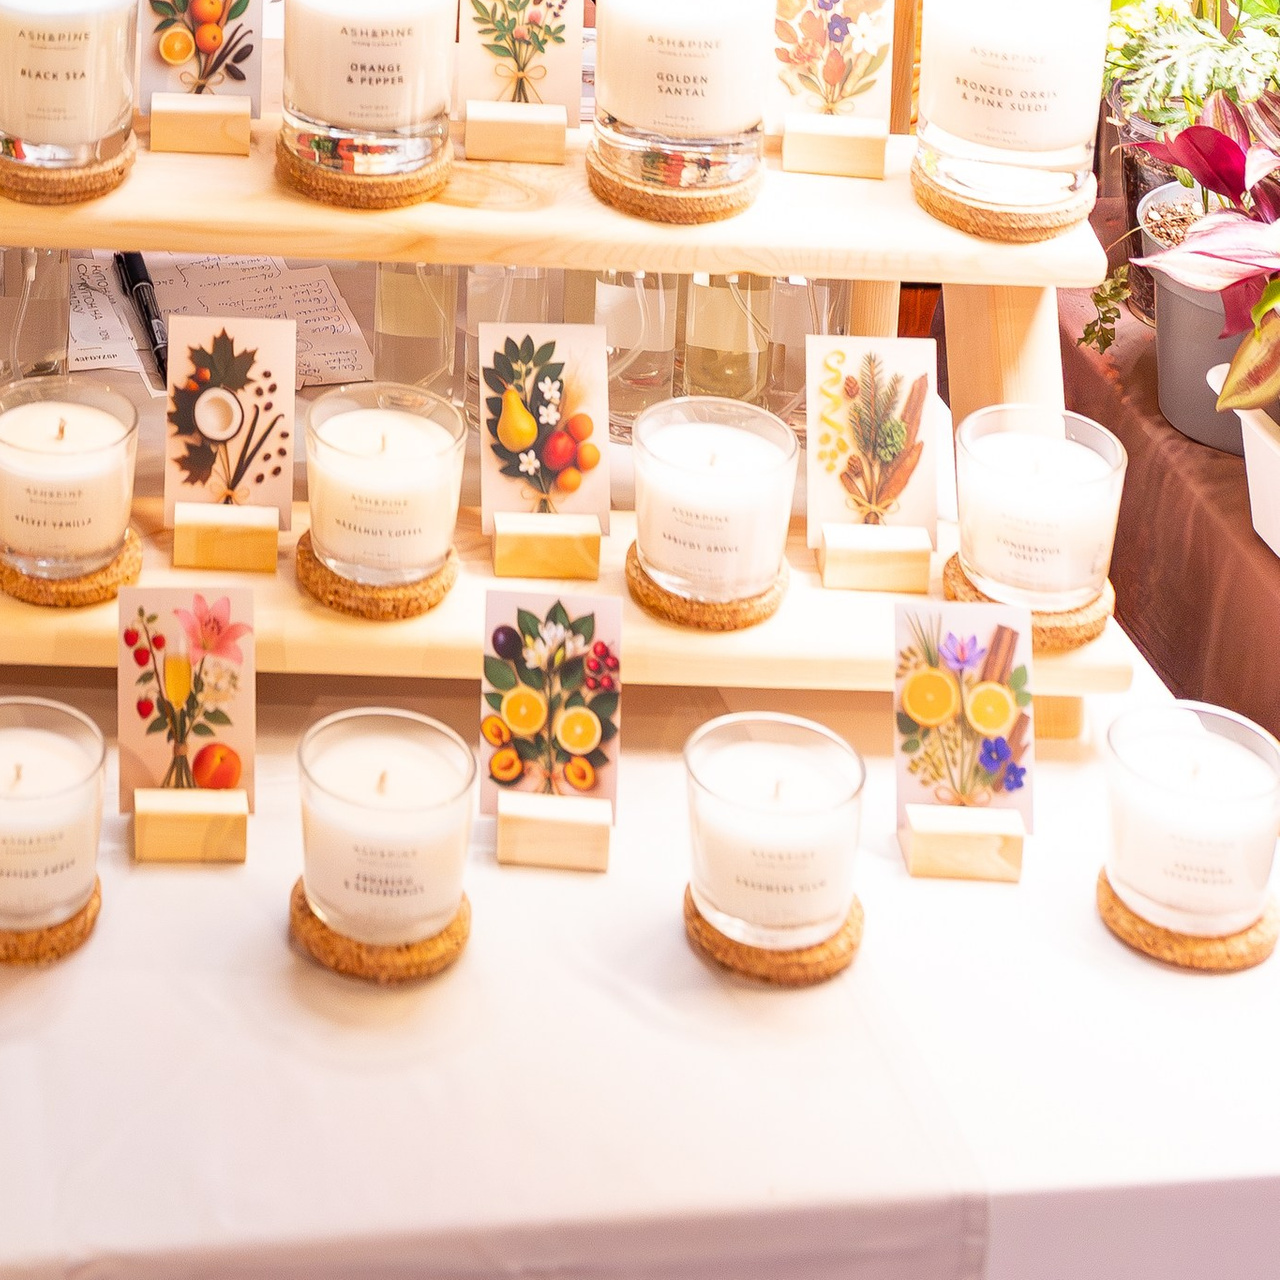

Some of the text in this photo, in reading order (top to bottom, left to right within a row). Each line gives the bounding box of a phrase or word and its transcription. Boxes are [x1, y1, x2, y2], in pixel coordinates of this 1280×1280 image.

[340, 24, 414, 39] ASH&PINE
[647, 33, 721, 50] ASH&PINE
[20, 66, 87, 81] BLACK SEA
[349, 60, 401, 75] ORANGE
[359, 74, 405, 87] PEPPER
[656, 70, 710, 86] GOLDEN
[656, 84, 707, 99] SANTAL
[954, 74, 1015, 100] BRONZED
[973, 93, 1005, 111] PINK
